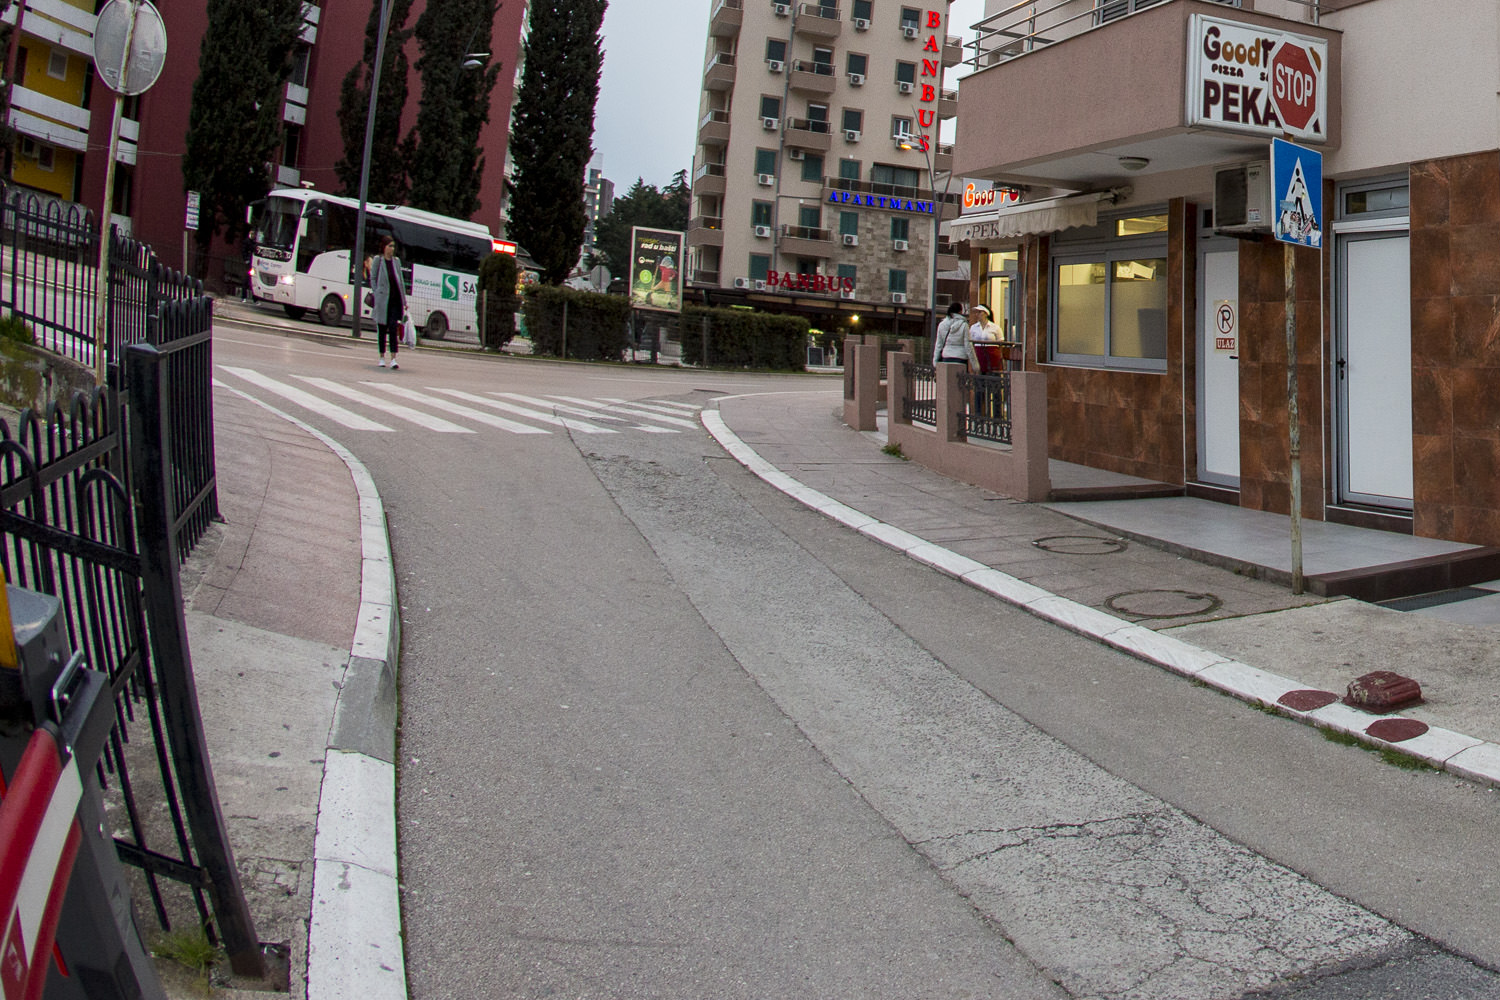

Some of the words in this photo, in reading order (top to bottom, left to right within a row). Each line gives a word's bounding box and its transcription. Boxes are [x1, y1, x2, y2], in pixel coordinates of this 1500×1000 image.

[1203, 25, 1261, 68] Good
[918, 10, 941, 152] BANBUS
[1211, 63, 1244, 78] PIZZA
[1275, 62, 1313, 108] STOP
[1203, 79, 1321, 133] PEKA
[828, 190, 934, 214] APARTMANI
[963, 182, 996, 208] Good
[766, 270, 854, 293] BANBUS
[1217, 339, 1235, 349] ULAZ
